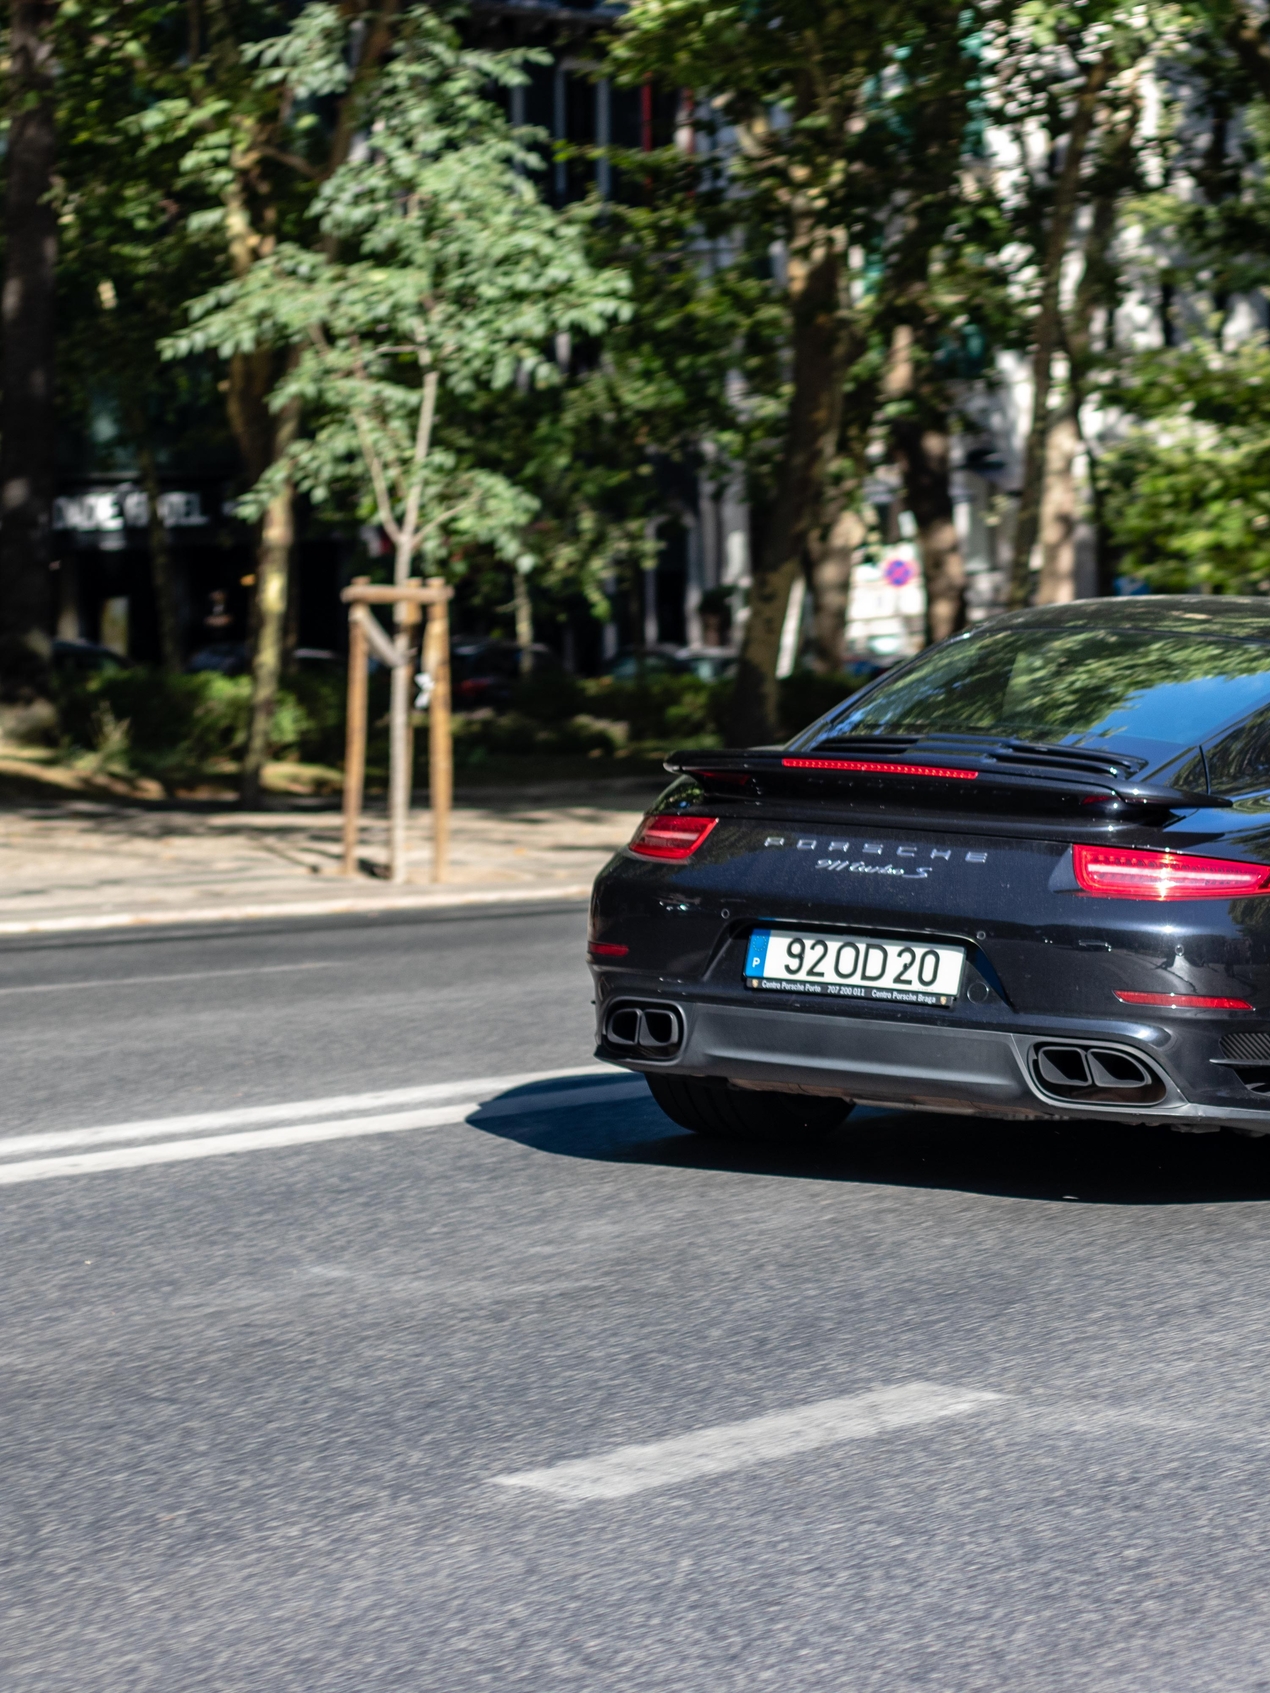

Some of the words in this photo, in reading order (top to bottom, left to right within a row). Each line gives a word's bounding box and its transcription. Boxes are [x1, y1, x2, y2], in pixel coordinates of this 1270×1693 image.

[764, 836, 988, 863] PORSCHE
[815, 858, 849, 871] 911
[849, 860, 904, 876] turbo
[902, 866, 933, 879] S
[752, 957, 761, 968] P
[761, 980, 781, 989] Centro
[781, 981, 805, 992] Porsche
[805, 983, 821, 993] Porto
[827, 985, 839, 994] 707
[840, 986, 853, 995] 200
[853, 987, 865, 997] 011
[871, 989, 892, 999] Centro
[892, 991, 917, 1001] Porsche
[917, 993, 937, 1004] Braga
